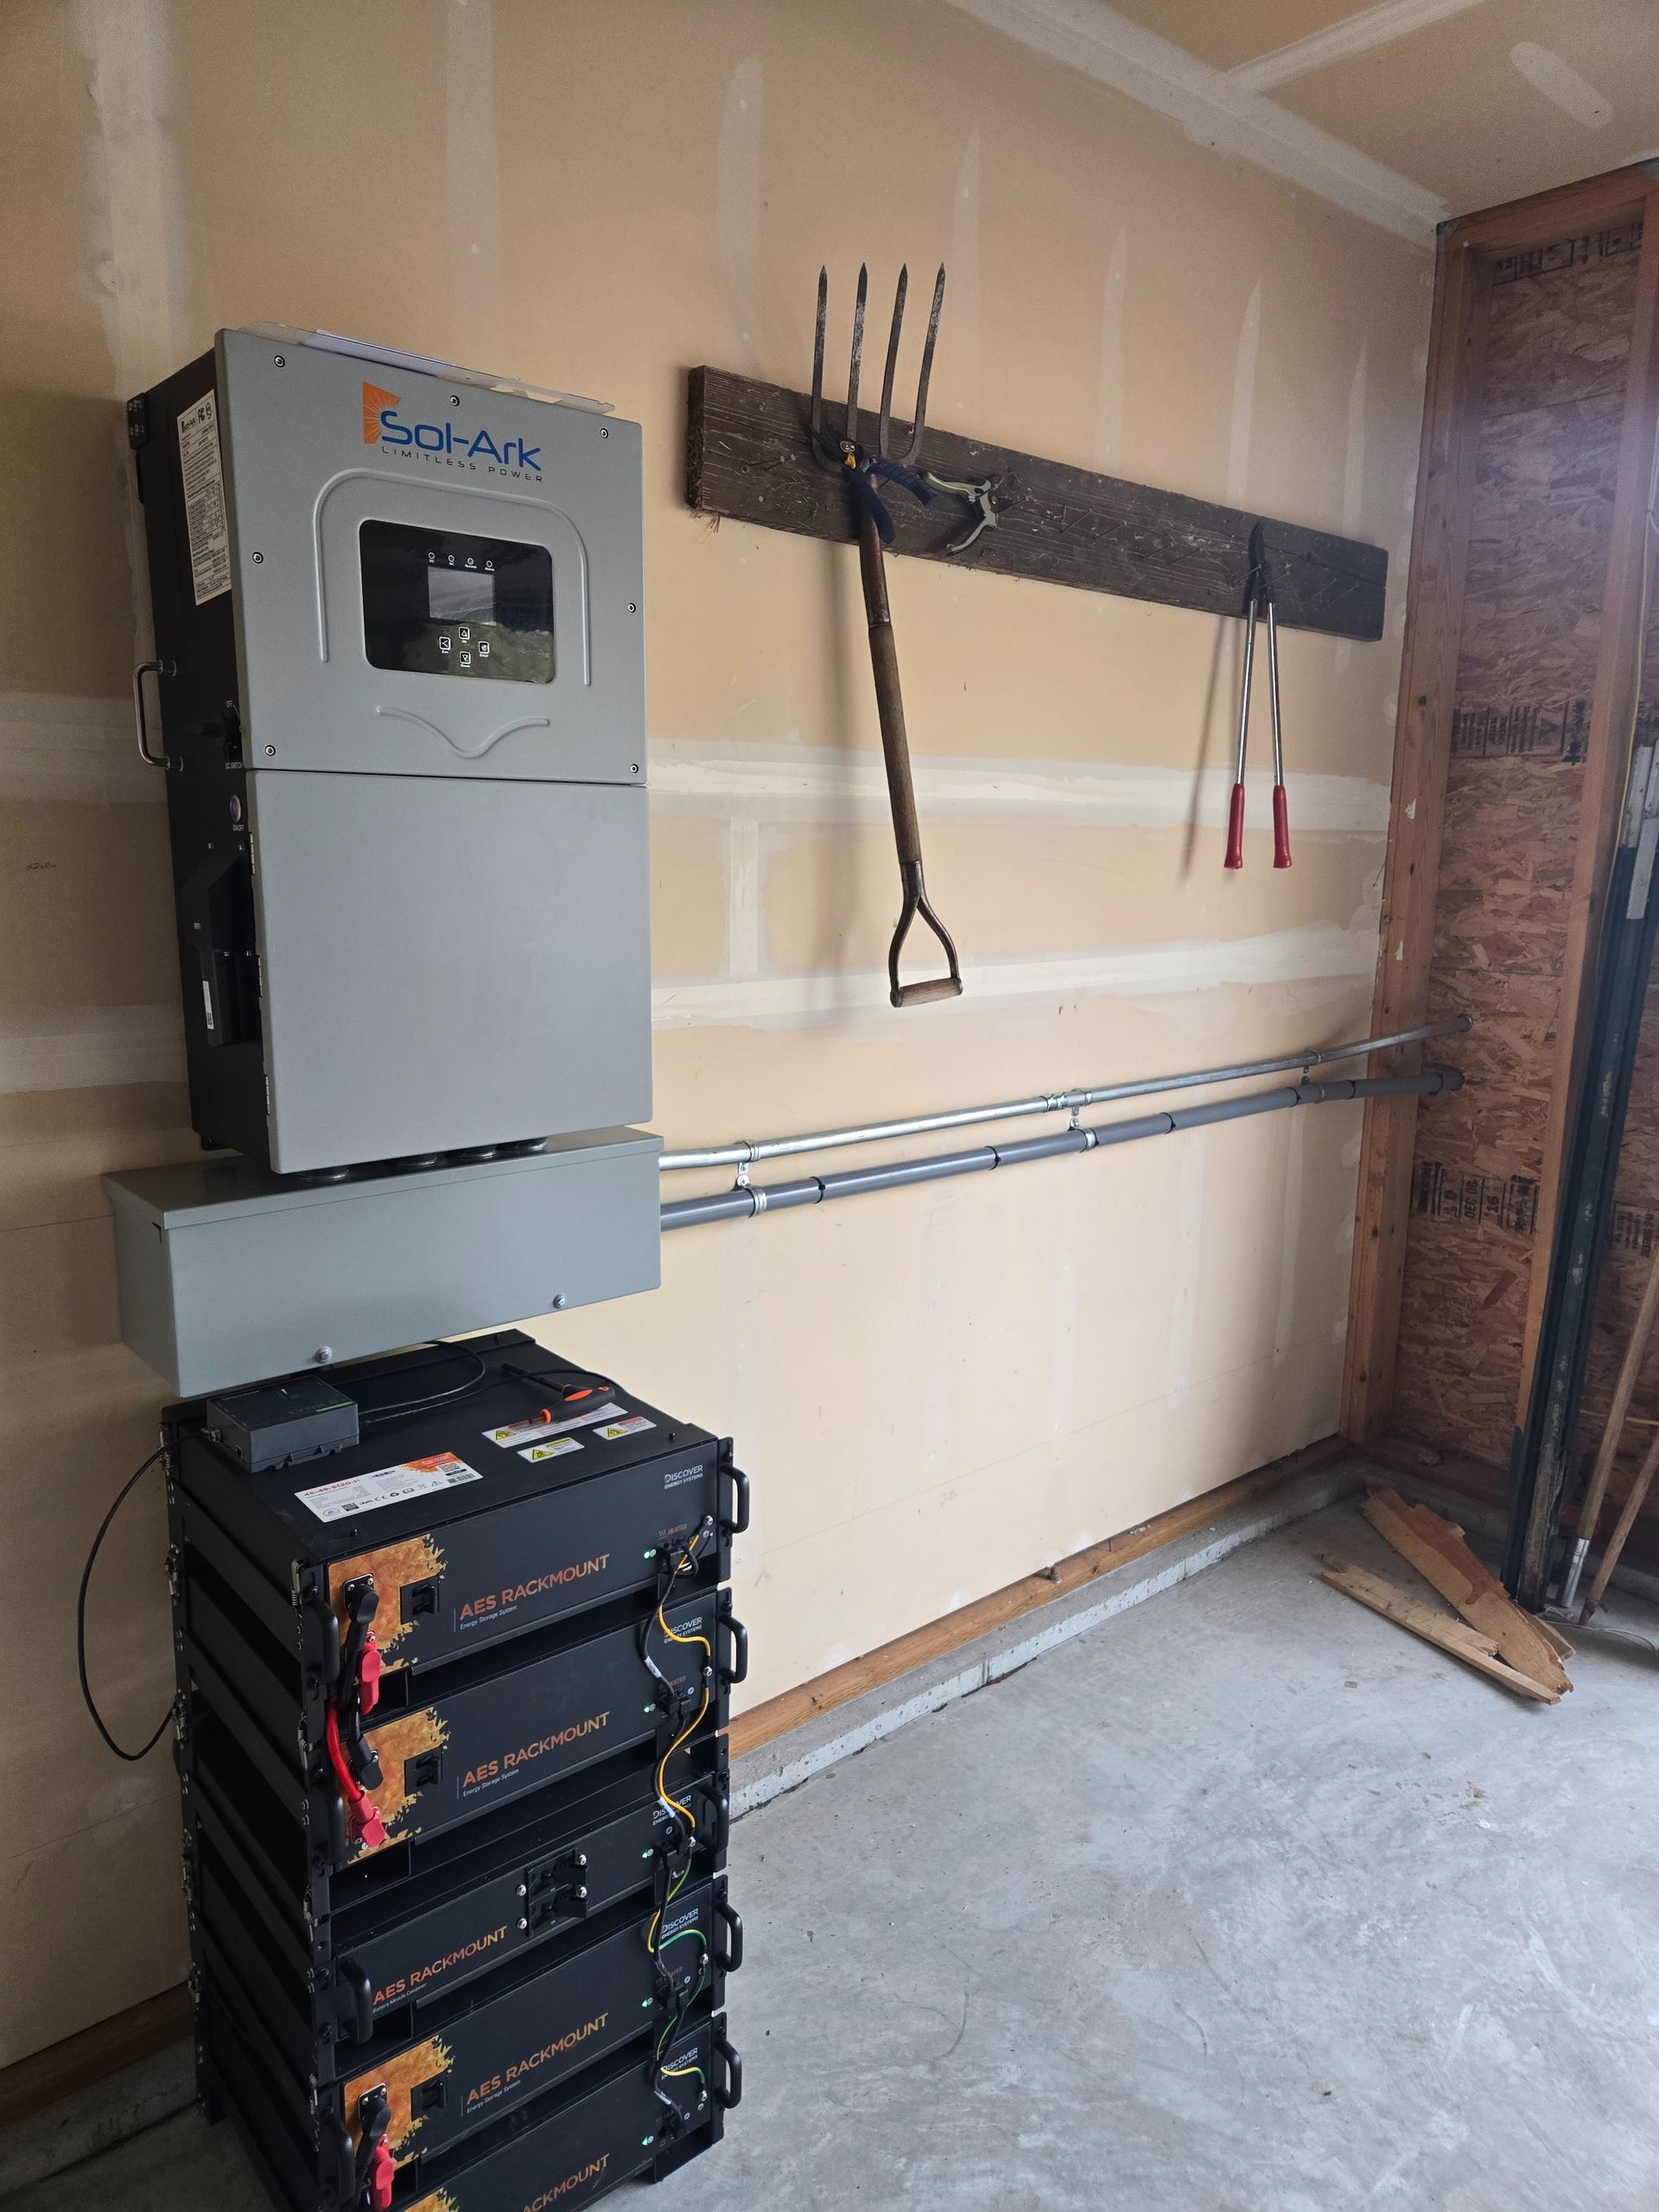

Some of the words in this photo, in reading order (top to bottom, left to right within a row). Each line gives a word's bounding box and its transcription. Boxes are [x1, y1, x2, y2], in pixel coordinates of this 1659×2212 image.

[380, 410, 542, 471] Sol-Ark
[381, 446, 477, 470] LIMITLESS
[487, 466, 543, 483] POWER
[664, 1465, 703, 1484] DISCOVER
[459, 1594, 497, 1621] AES
[501, 1554, 610, 1605] RACKMOUNT
[460, 1618, 479, 1630] Energy
[479, 1611, 499, 1624] Storage
[499, 1605, 518, 1617] System
[462, 1759, 499, 1789] AES
[503, 1711, 610, 1770] RACKMOUNT
[462, 1785, 481, 1797] Energy
[481, 1777, 500, 1789] Storage
[661, 1908, 699, 1934] DISCOVER
[372, 1978, 406, 2005] AES
[410, 1925, 507, 1986] RACKMOUNT
[466, 2075, 501, 2106] AES
[505, 2012, 609, 2082] RACKMOUNT
[467, 2101, 484, 2114] Energy
[484, 2090, 503, 2104] Storage
